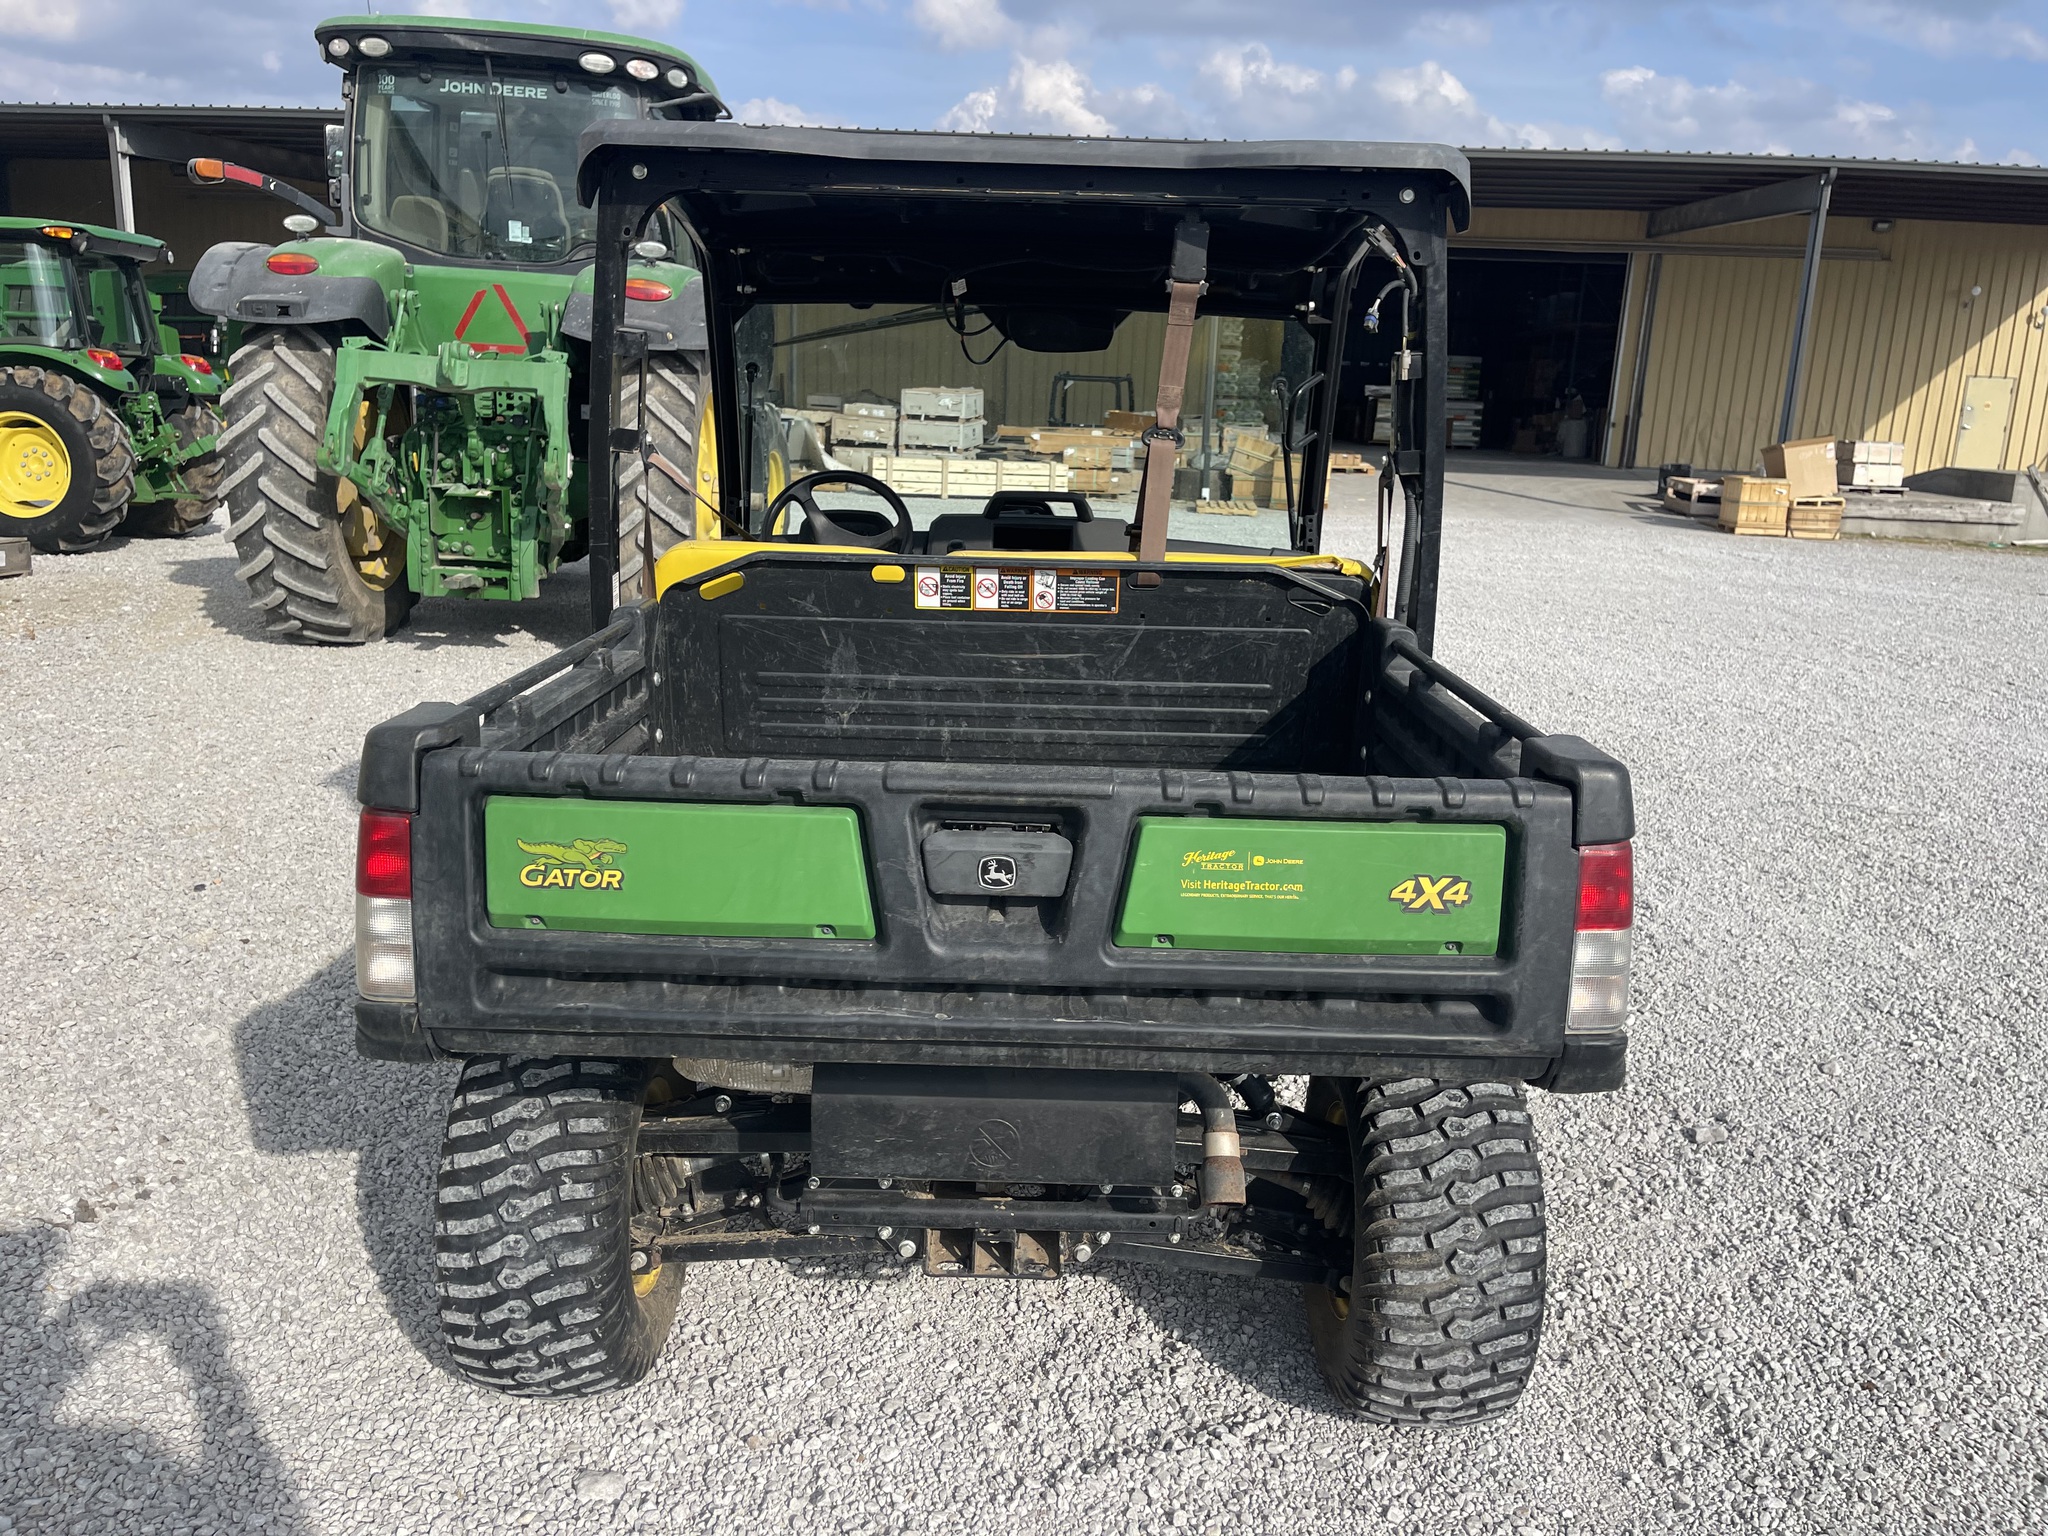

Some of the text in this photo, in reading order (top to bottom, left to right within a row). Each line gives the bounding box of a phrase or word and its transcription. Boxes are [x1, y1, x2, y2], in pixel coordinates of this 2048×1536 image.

[378, 74, 395, 85] 100
[440, 79, 548, 99] JOHN DEERE
[1182, 850, 1236, 867] Heritage
[520, 864, 624, 890] GATOR
[1181, 879, 1304, 892] Visit HeritageTractor.com
[1389, 875, 1472, 914] 4X4
